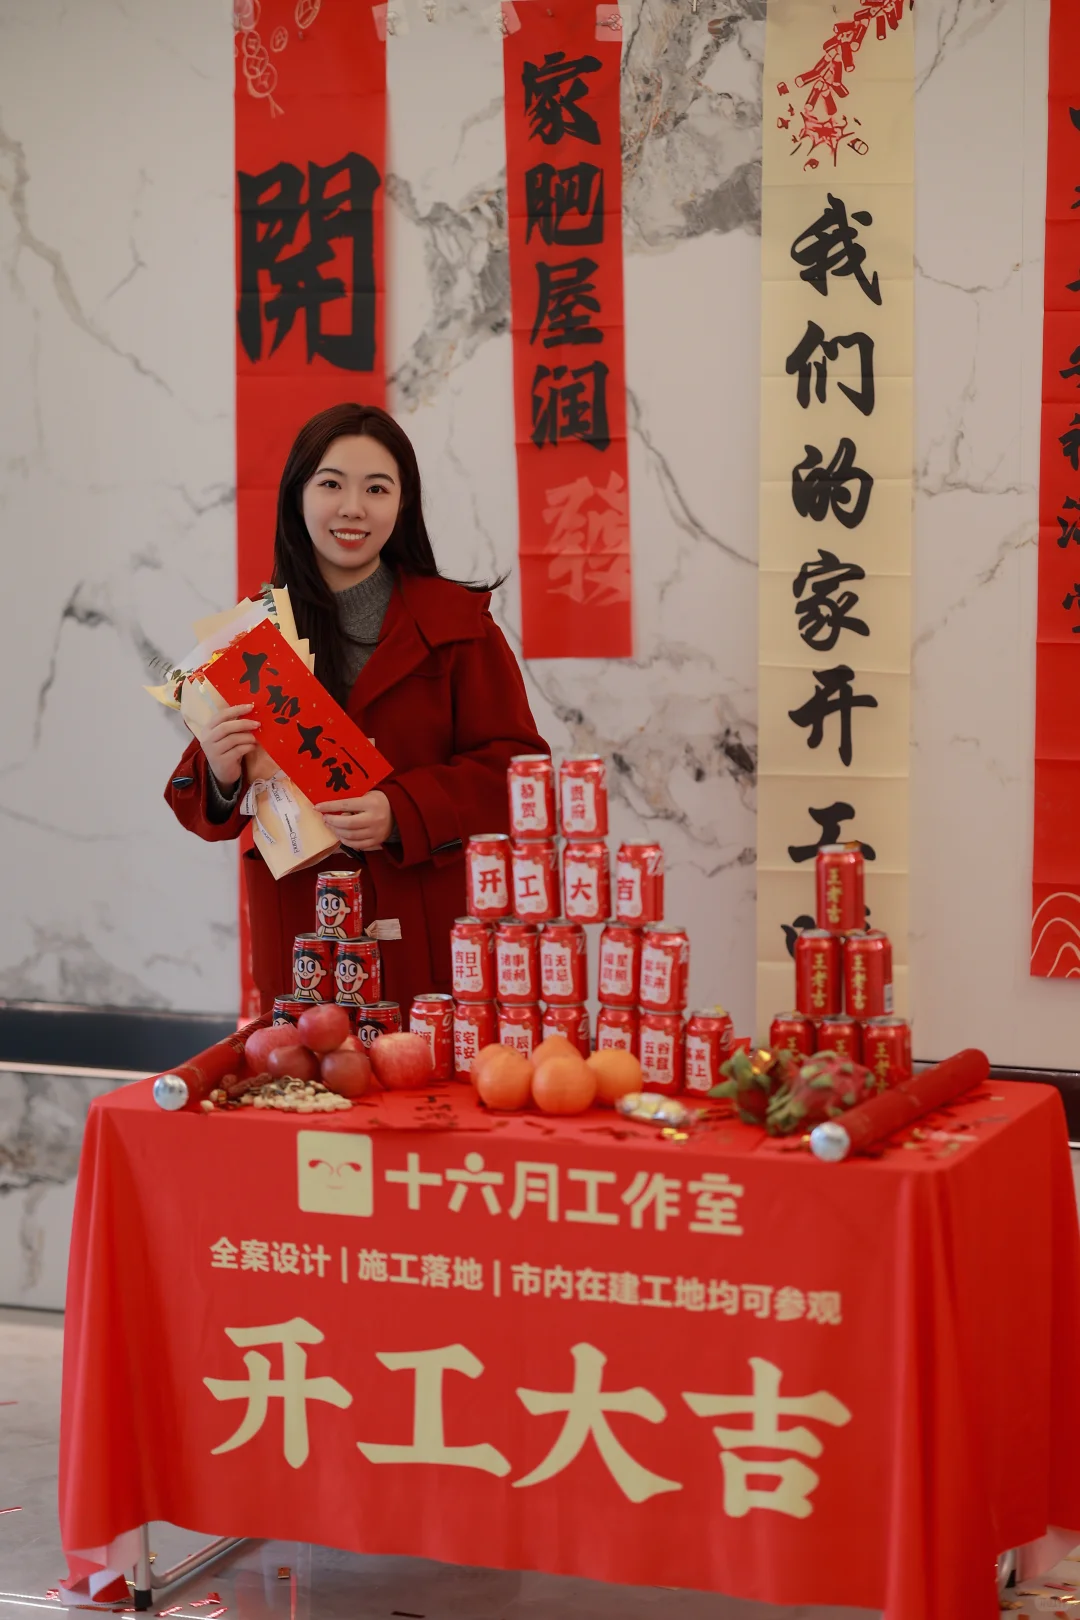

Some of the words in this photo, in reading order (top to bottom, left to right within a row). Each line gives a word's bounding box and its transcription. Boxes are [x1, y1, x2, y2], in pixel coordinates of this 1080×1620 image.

[237, 152, 381, 372] 開
[522, 51, 611, 452] 家肥屋润
[781, 192, 882, 960] 我们的家开工
[239, 651, 370, 793] 大吉大利
[478, 868, 502, 893] 开
[518, 875, 540, 898] 工
[570, 878, 592, 901] 大
[617, 877, 635, 901] 吉
[826, 867, 843, 924] 王老吉
[810, 953, 828, 1009] 王老吉
[851, 954, 868, 1010] 王老吉
[385, 1152, 744, 1235] 十六月工作室
[209, 1237, 332, 1278] 全案设计
[358, 1249, 484, 1291] 施工落地
[510, 1263, 843, 1326] 市内在建工地均可参观
[202, 1316, 852, 1519] 开工大吉
